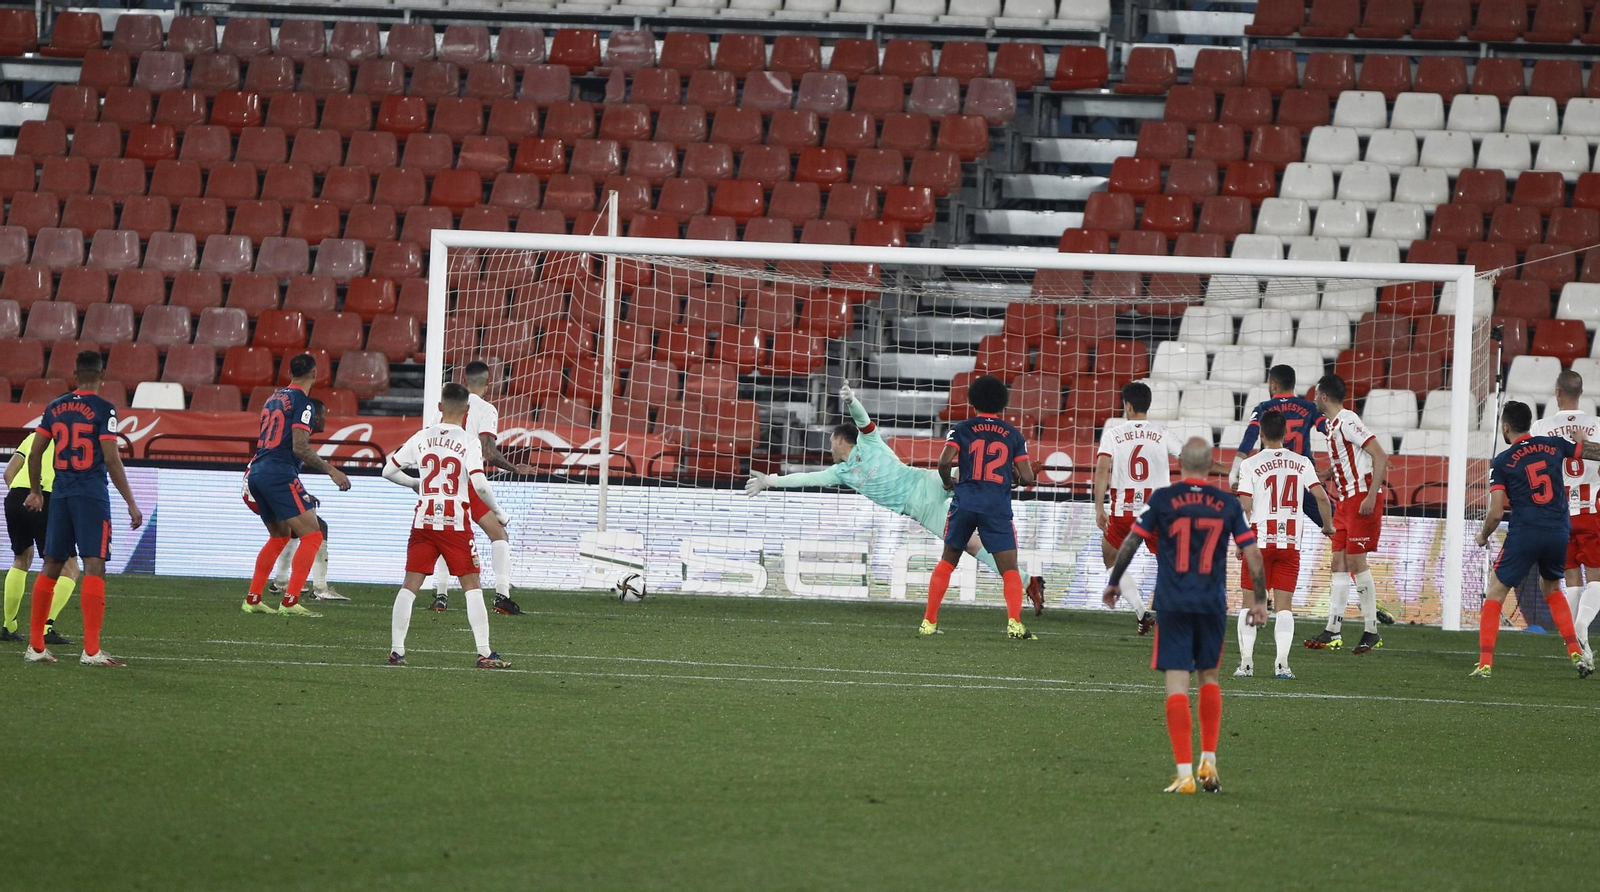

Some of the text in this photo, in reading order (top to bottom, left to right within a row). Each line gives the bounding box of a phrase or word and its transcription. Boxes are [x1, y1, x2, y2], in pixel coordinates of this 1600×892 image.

[51, 402, 96, 420] FERNANDO
[257, 408, 286, 450] 20
[51, 421, 95, 471] 25
[417, 436, 467, 459] F. VILLALBA
[1114, 435, 1125, 444] C.
[1146, 430, 1163, 444] HOZ
[420, 453, 462, 497] 23
[968, 438, 1009, 484] 12
[1127, 443, 1149, 483] 6
[1254, 459, 1306, 478] ROBERTONE
[1524, 459, 1554, 505] 5
[1170, 492, 1204, 511] ALEIX
[1263, 473, 1299, 515] 14
[1168, 516, 1225, 574] 17
